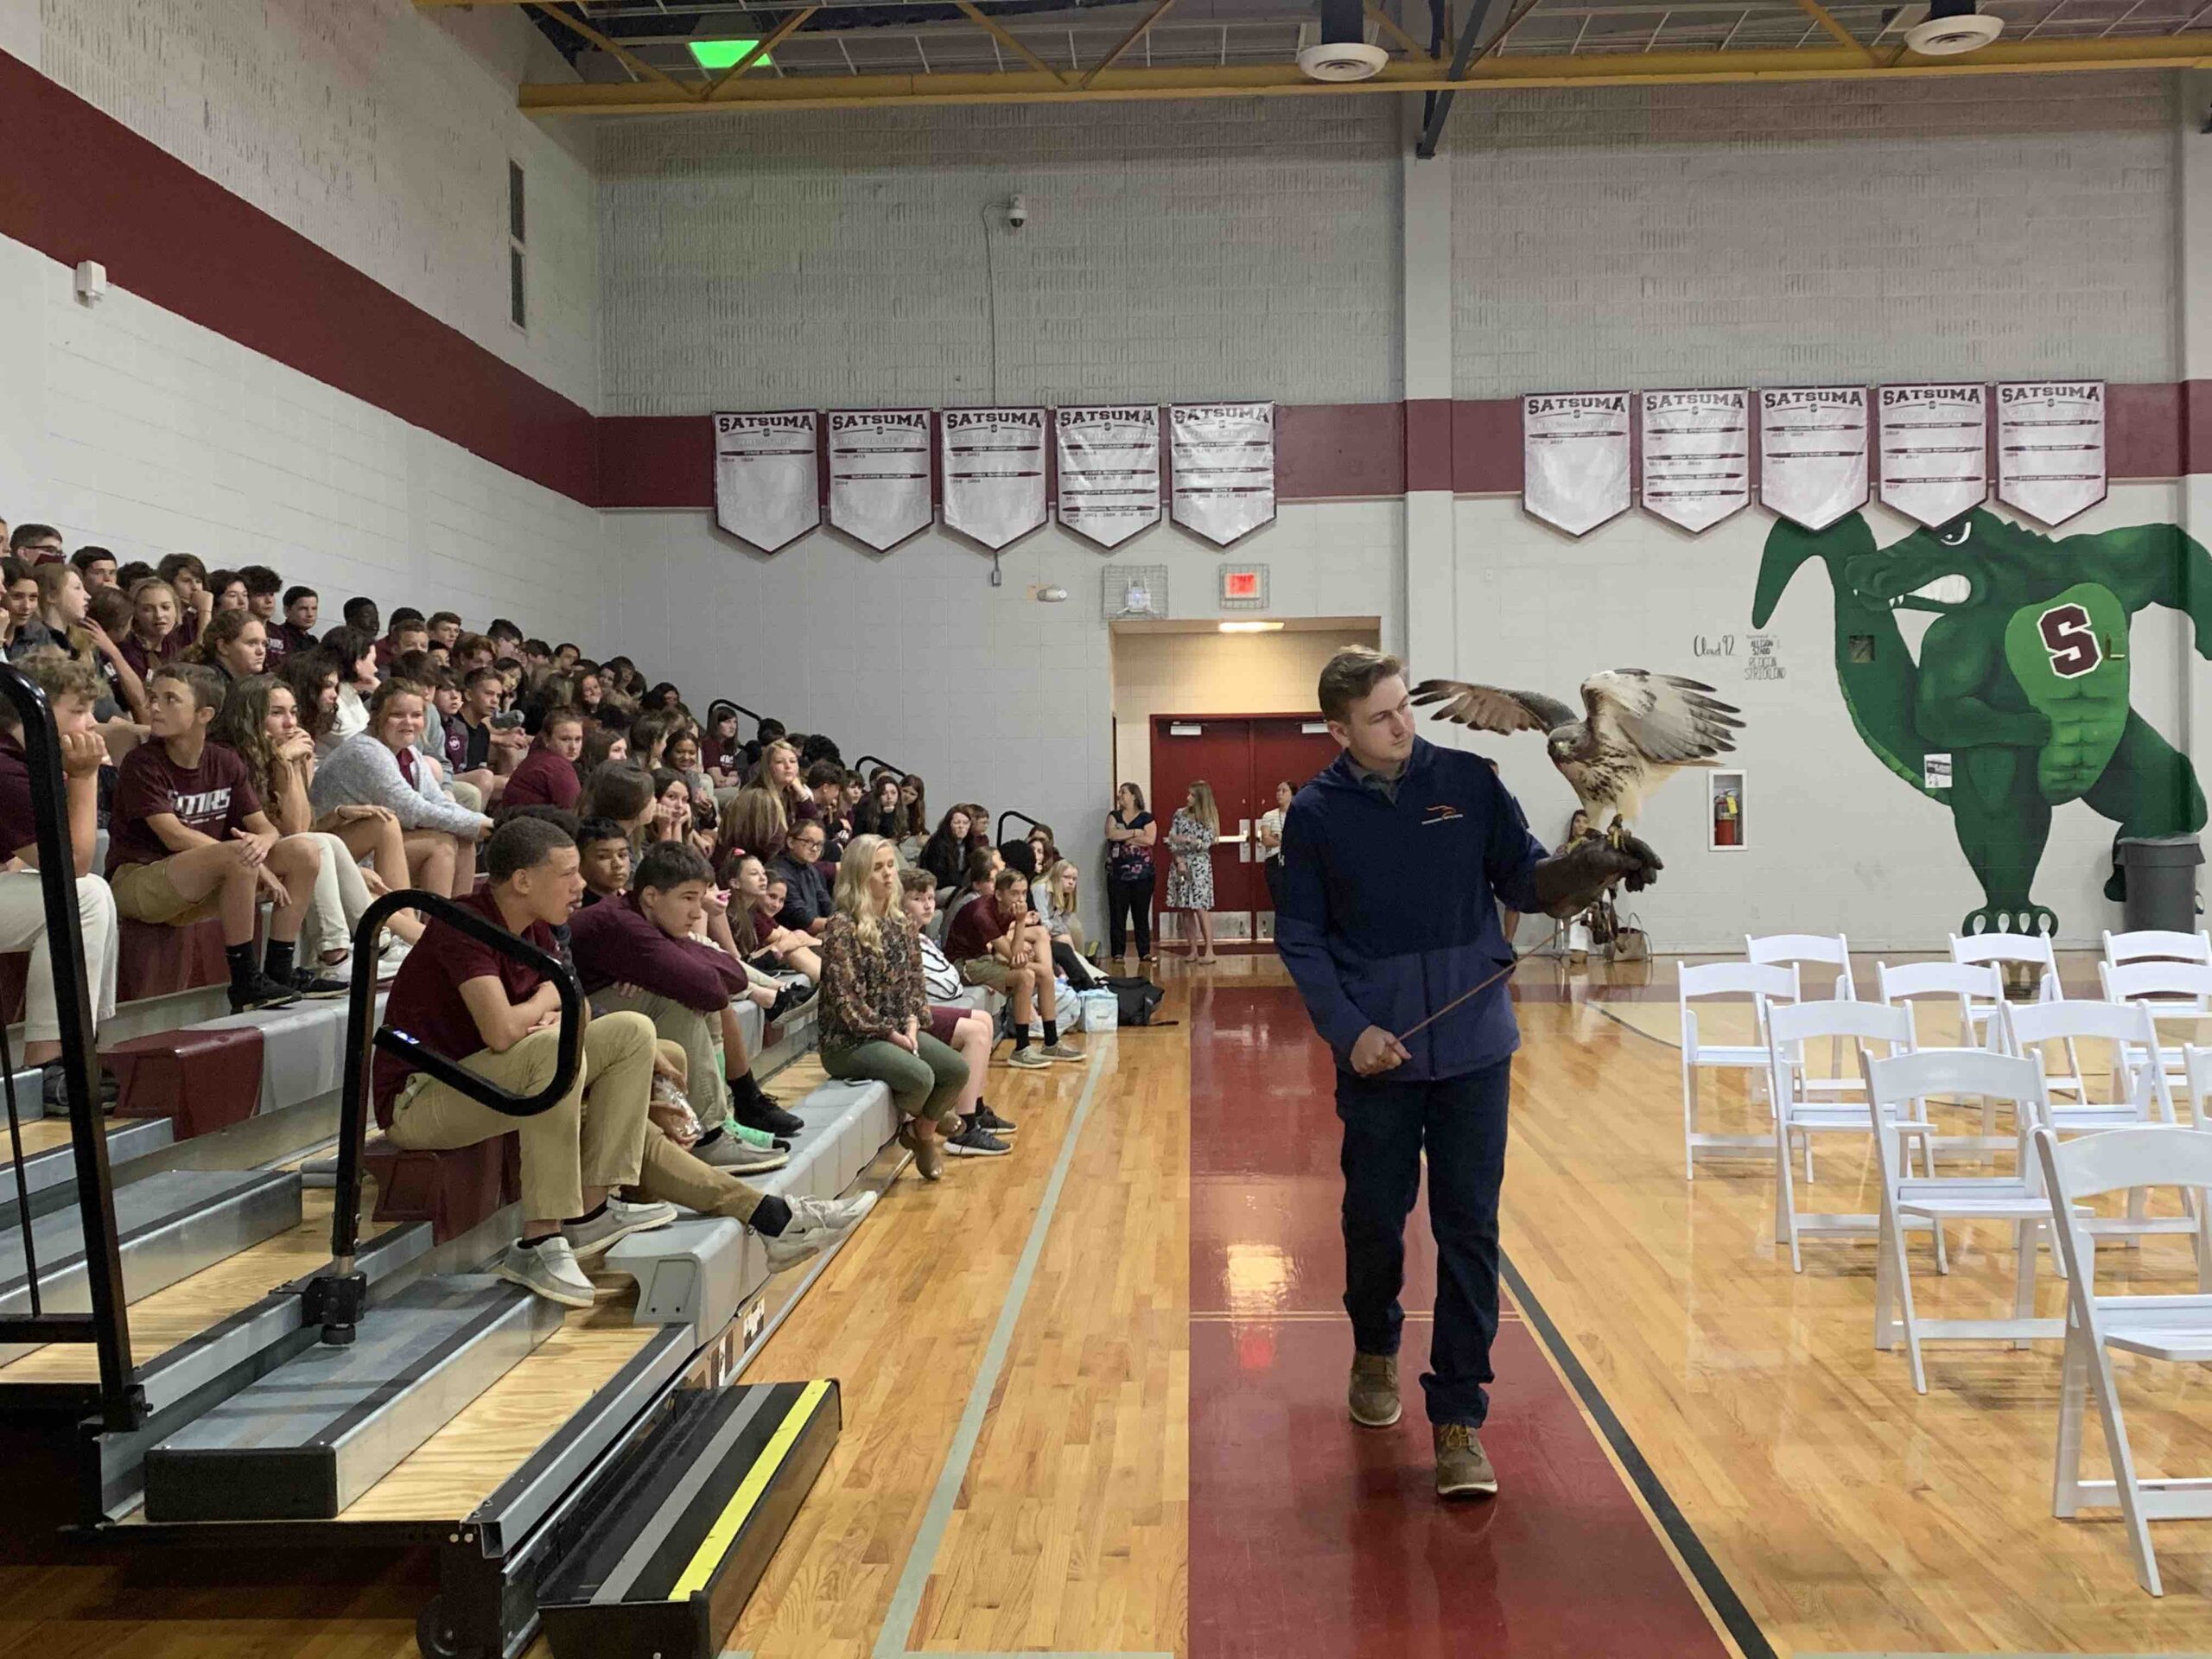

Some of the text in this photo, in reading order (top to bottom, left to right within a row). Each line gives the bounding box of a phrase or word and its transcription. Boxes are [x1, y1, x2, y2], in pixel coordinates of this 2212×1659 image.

[1646, 394, 1744, 411] SATSUMA
[1764, 391, 1863, 409] SATSUMA
[1884, 388, 1981, 406] SATSUMA
[2002, 386, 2100, 404] SATSUMA
[1528, 397, 1625, 415] SATSUMA
[832, 414, 927, 430] SATSUMA
[947, 412, 1042, 429] SATSUMA
[1060, 410, 1154, 427] SATSUMA
[1174, 407, 1269, 424] SATSUMA
[719, 416, 813, 433] SATSUMA
[2037, 603, 2103, 679] S
